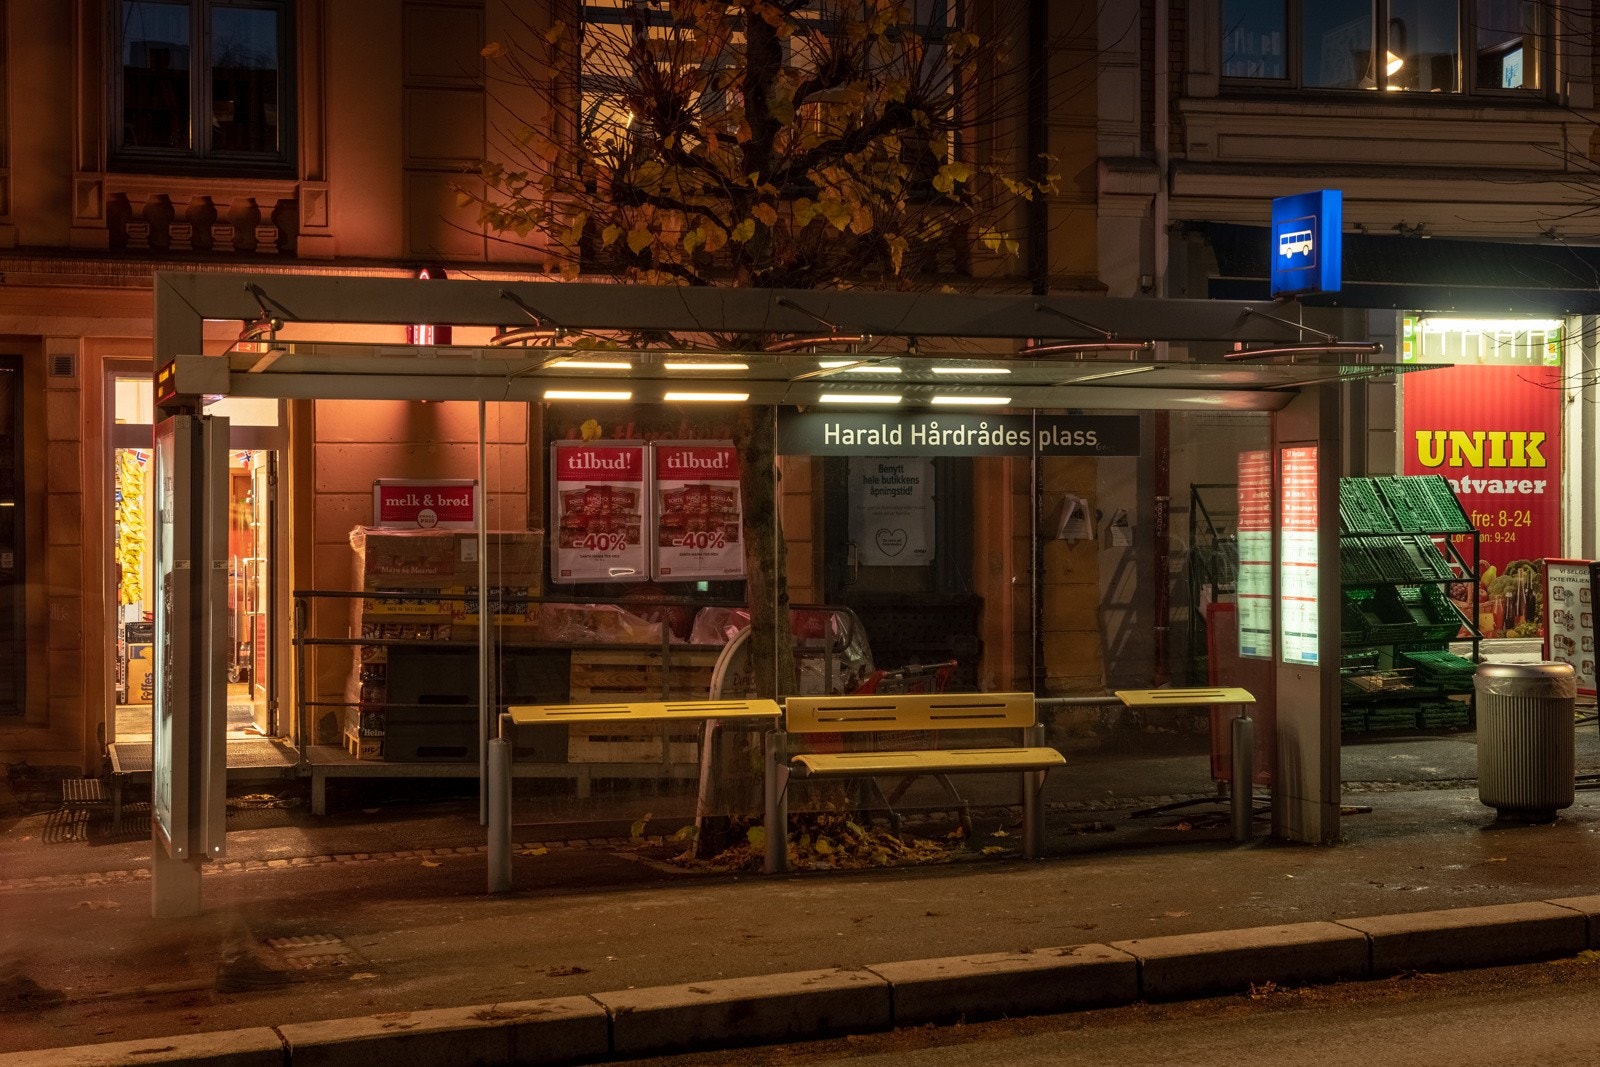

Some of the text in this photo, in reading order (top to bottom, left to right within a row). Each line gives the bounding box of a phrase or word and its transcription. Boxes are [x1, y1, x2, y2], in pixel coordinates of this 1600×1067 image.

[824, 423, 902, 446] Harald
[911, 421, 1030, 446] Hårdrådes
[1039, 424, 1098, 450] plass
[1415, 430, 1547, 468] UNIK
[568, 452, 631, 469] tilbud!
[667, 452, 729, 468] tilbud!
[878, 464, 904, 475] Benytt
[863, 475, 920, 484] hele butikkens
[1449, 475, 1547, 494] atvarer
[870, 485, 913, 498] åpningstid!
[385, 494, 469, 506] melk & brød
[1472, 510, 1532, 527] fre: 8-24
[574, 534, 627, 551] -40%
[673, 532, 726, 550] -40%
[1480, 532, 1492, 542] øn:
[1495, 532, 1516, 542] 9-24
[364, 728, 385, 737] Hein
